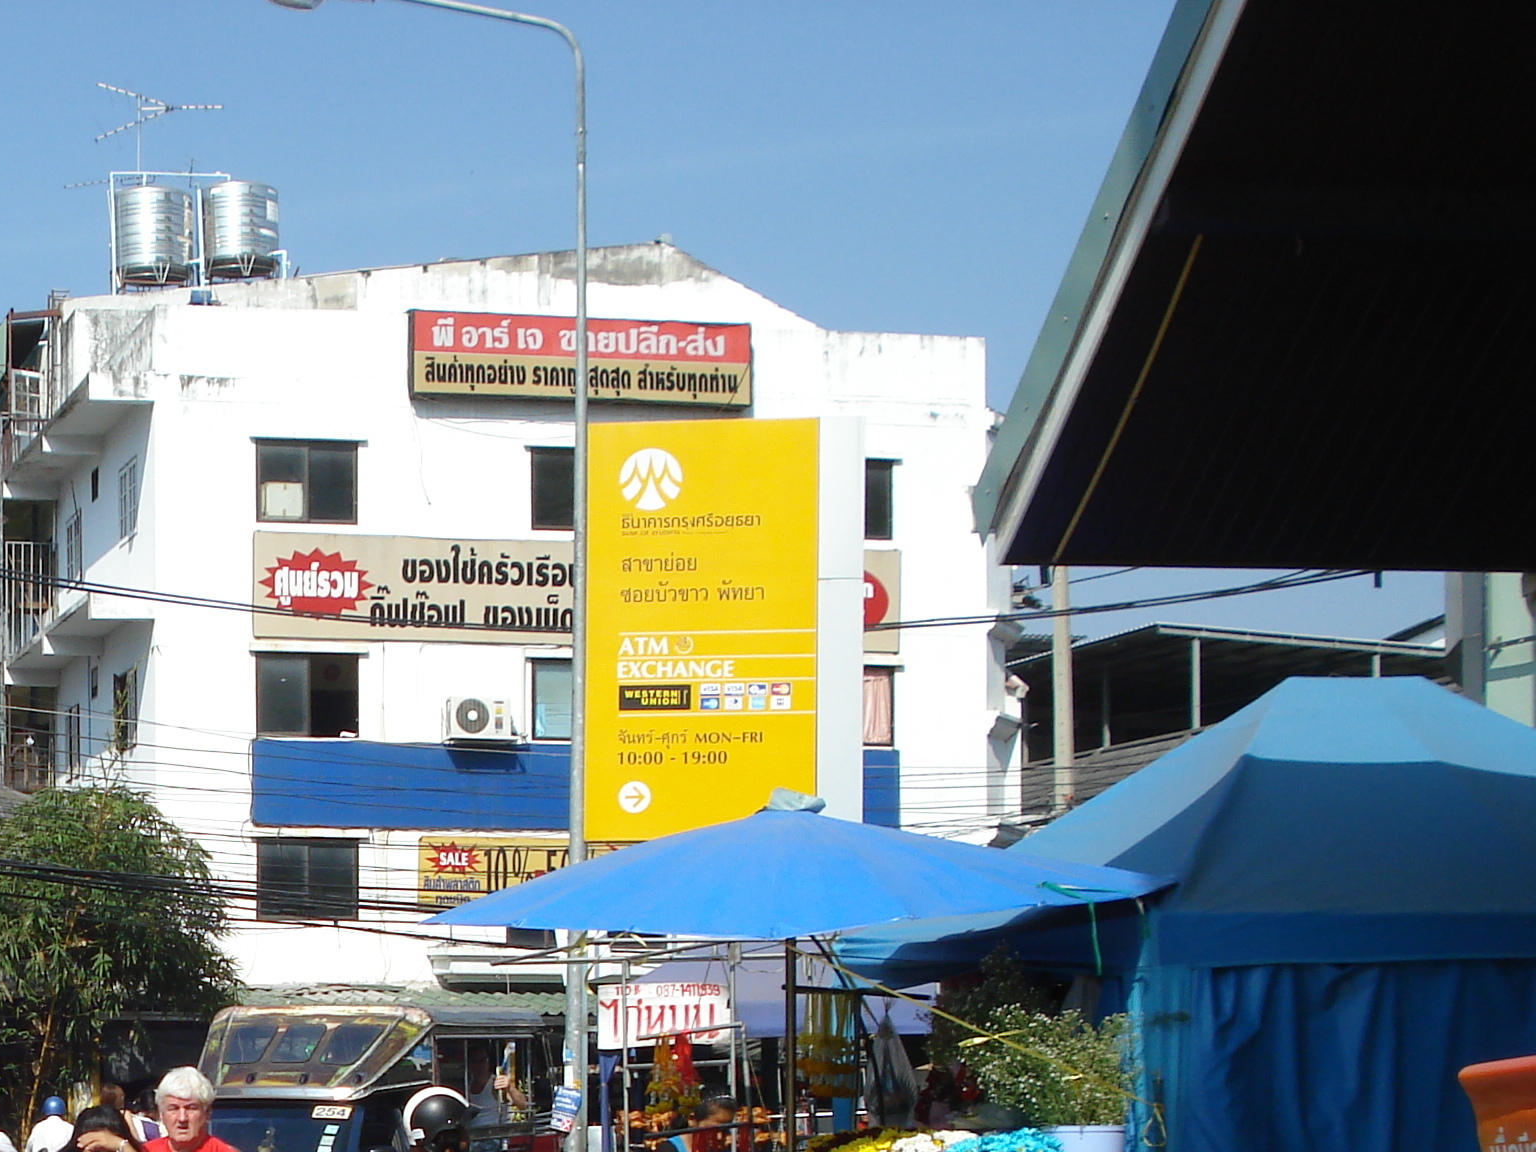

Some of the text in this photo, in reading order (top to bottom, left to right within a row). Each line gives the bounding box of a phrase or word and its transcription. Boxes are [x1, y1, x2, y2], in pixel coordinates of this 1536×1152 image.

[532, 364, 631, 397] ราคาถูสุดสุด
[621, 552, 697, 572] สาขาย่อย
[274, 561, 359, 607] ศูนย์รวม
[620, 580, 765, 603] ซอยบัวขาว พัทยา
[618, 636, 670, 656] ATM
[616, 659, 736, 679] EXCHANGE
[624, 689, 679, 699] WESTERN
[640, 697, 679, 707] UNION
[617, 750, 663, 766] 10:00
[682, 750, 728, 765] 19:00
[439, 851, 470, 867] SALE
[315, 1107, 347, 1117] 254
